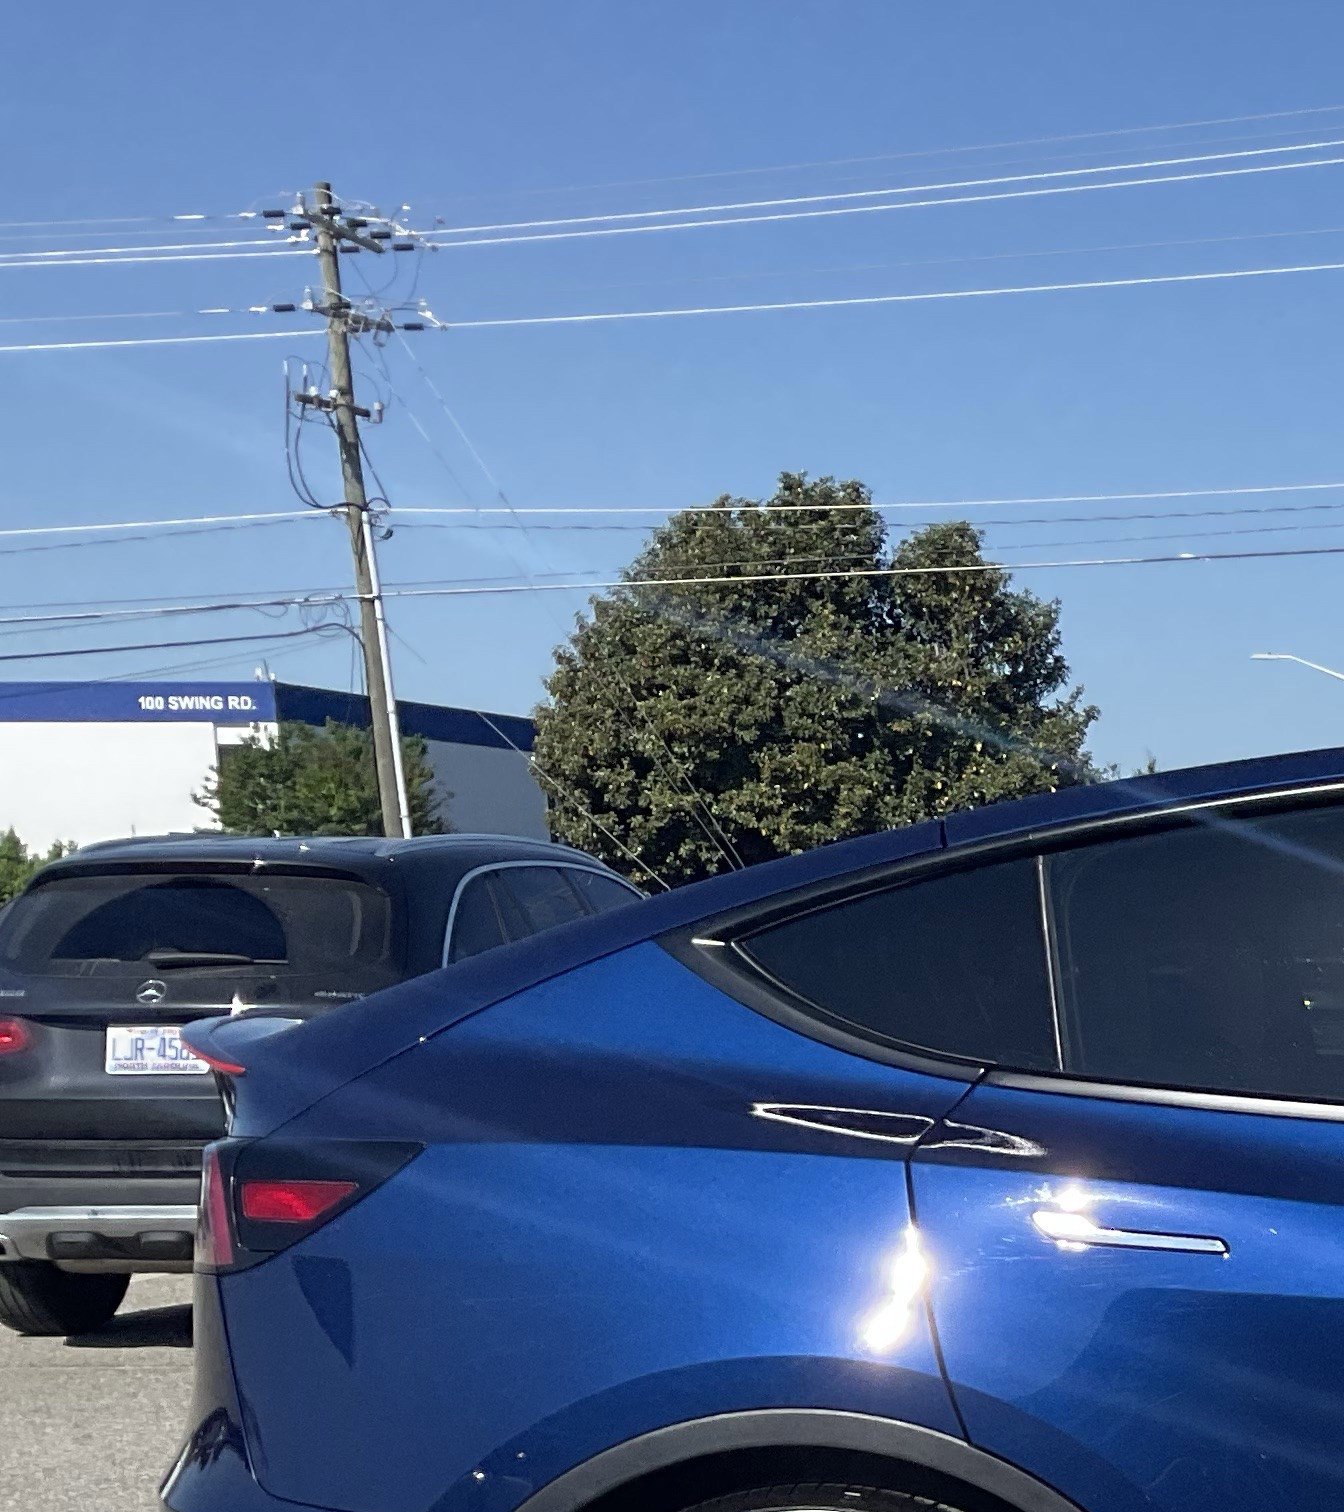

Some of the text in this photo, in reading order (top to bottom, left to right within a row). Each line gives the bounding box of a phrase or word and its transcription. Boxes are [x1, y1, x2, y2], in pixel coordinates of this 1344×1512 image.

[138, 696, 257, 710] 100 SWING RD.
